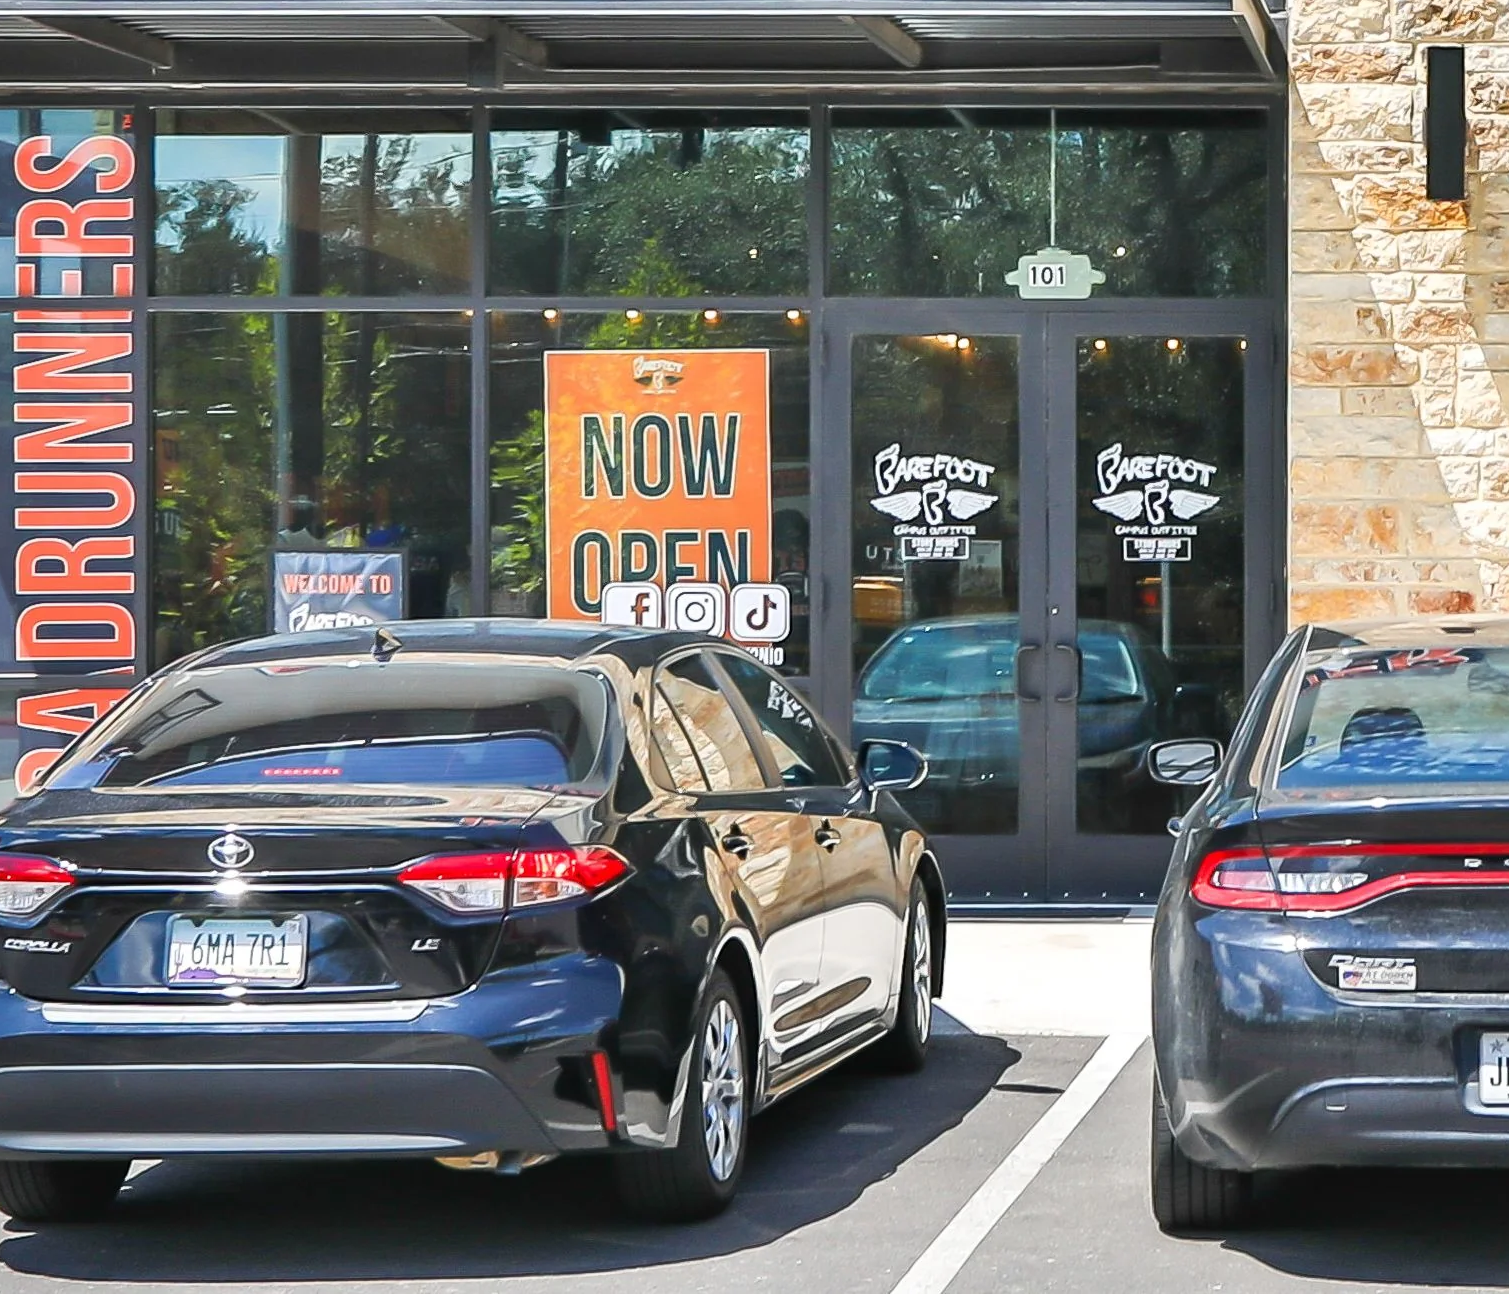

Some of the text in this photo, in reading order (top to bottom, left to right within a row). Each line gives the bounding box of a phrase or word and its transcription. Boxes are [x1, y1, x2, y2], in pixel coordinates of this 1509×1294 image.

[1030, 266, 1065, 285] 101
[13, 134, 136, 796] ADRUNNERS
[579, 412, 741, 500] NOW
[875, 443, 995, 495] BAREFOOT
[1097, 442, 1217, 494] BAREFOOT
[283, 574, 393, 595] WELCOME TO
[4, 938, 72, 954] COROLLA
[191, 932, 290, 966] 6MA 7R1
[411, 938, 441, 951] LE
